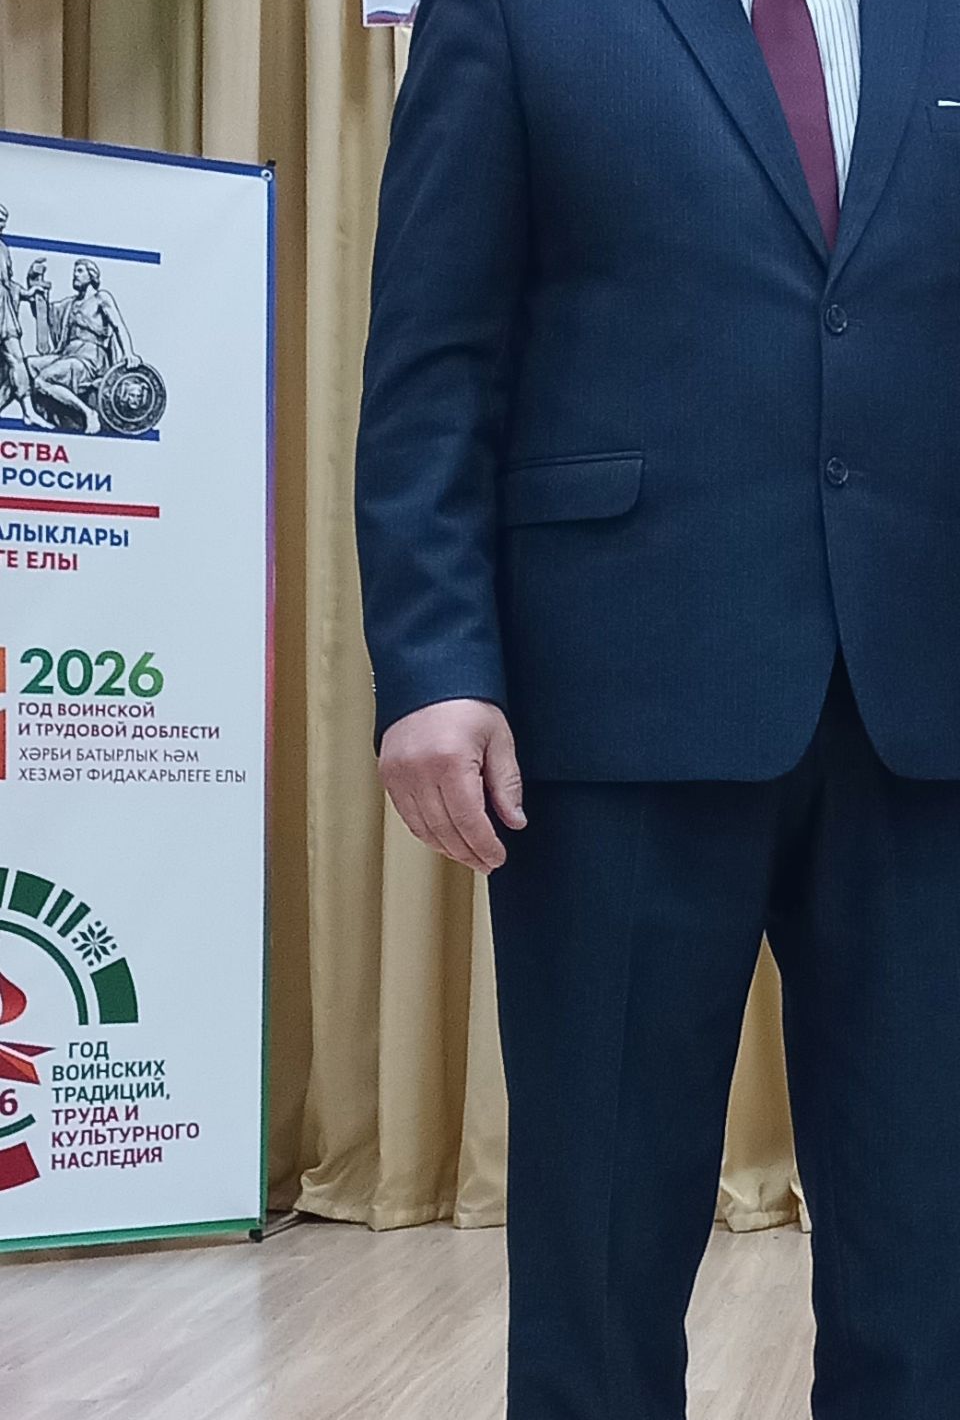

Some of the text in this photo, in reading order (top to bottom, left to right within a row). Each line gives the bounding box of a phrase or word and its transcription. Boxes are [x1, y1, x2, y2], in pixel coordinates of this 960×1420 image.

[0, 441, 70, 464] СТВА
[2, 467, 112, 492] РОССИИ
[27, 551, 78, 571] ЕЛЫ
[20, 647, 164, 698] 2026
[18, 701, 155, 719] ГОД ВОИНСКОЙ
[18, 721, 220, 740] И ТРУДОВОЙ ДОБЛЕСТИ
[19, 747, 71, 761] ХӘРБИ
[76, 748, 158, 762] БАТЫРЛЫК
[19, 768, 246, 784] ХЕЗМӘТ ФИДАКАРЬЛЕГЕ ЕЛЫ
[69, 1041, 109, 1061] ГОД
[52, 1060, 165, 1081] ВОИНСКИХ
[0, 1088, 18, 1116] 6
[52, 1077, 170, 1105] ТРАДИЦИЙ,
[52, 1105, 139, 1127] ТРУДА И
[52, 1122, 199, 1148] КУЛЬТУРНОГО
[52, 1147, 163, 1170] НАСЛЕДИЯ
